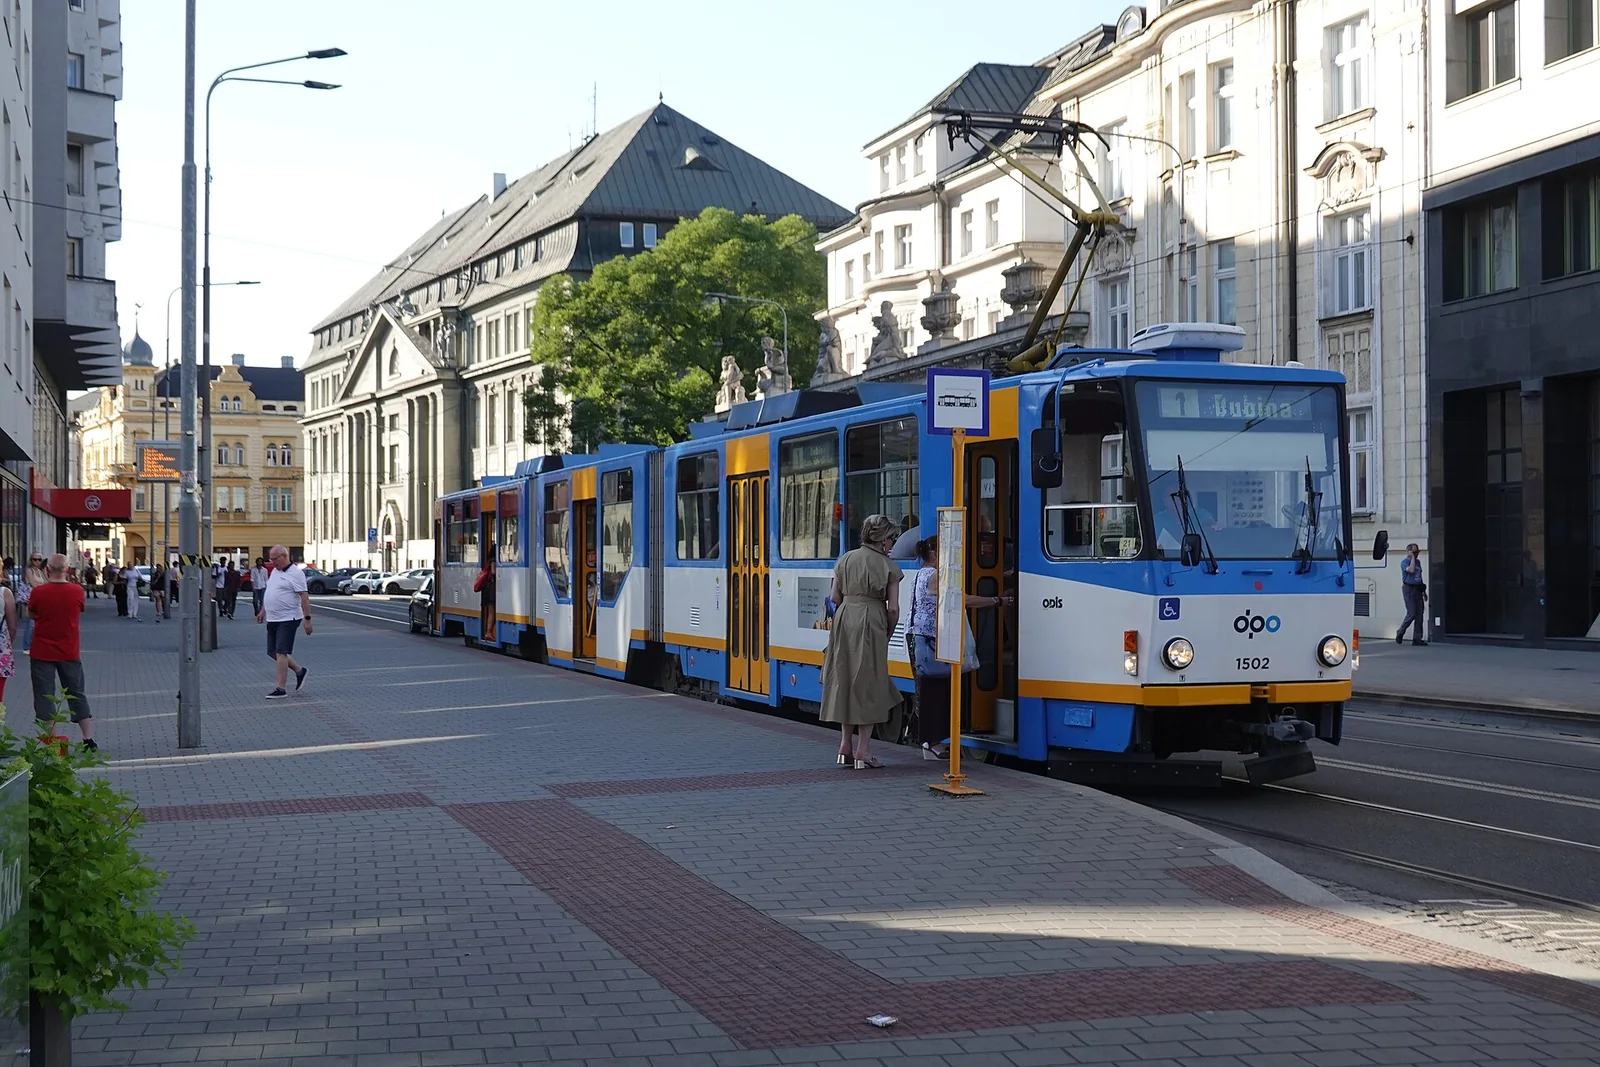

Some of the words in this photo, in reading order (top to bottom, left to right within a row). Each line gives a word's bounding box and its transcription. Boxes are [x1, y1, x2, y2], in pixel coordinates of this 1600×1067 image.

[1175, 391, 1186, 416] 1
[1233, 609, 1281, 639] dpo
[1236, 657, 1270, 670] 1502
